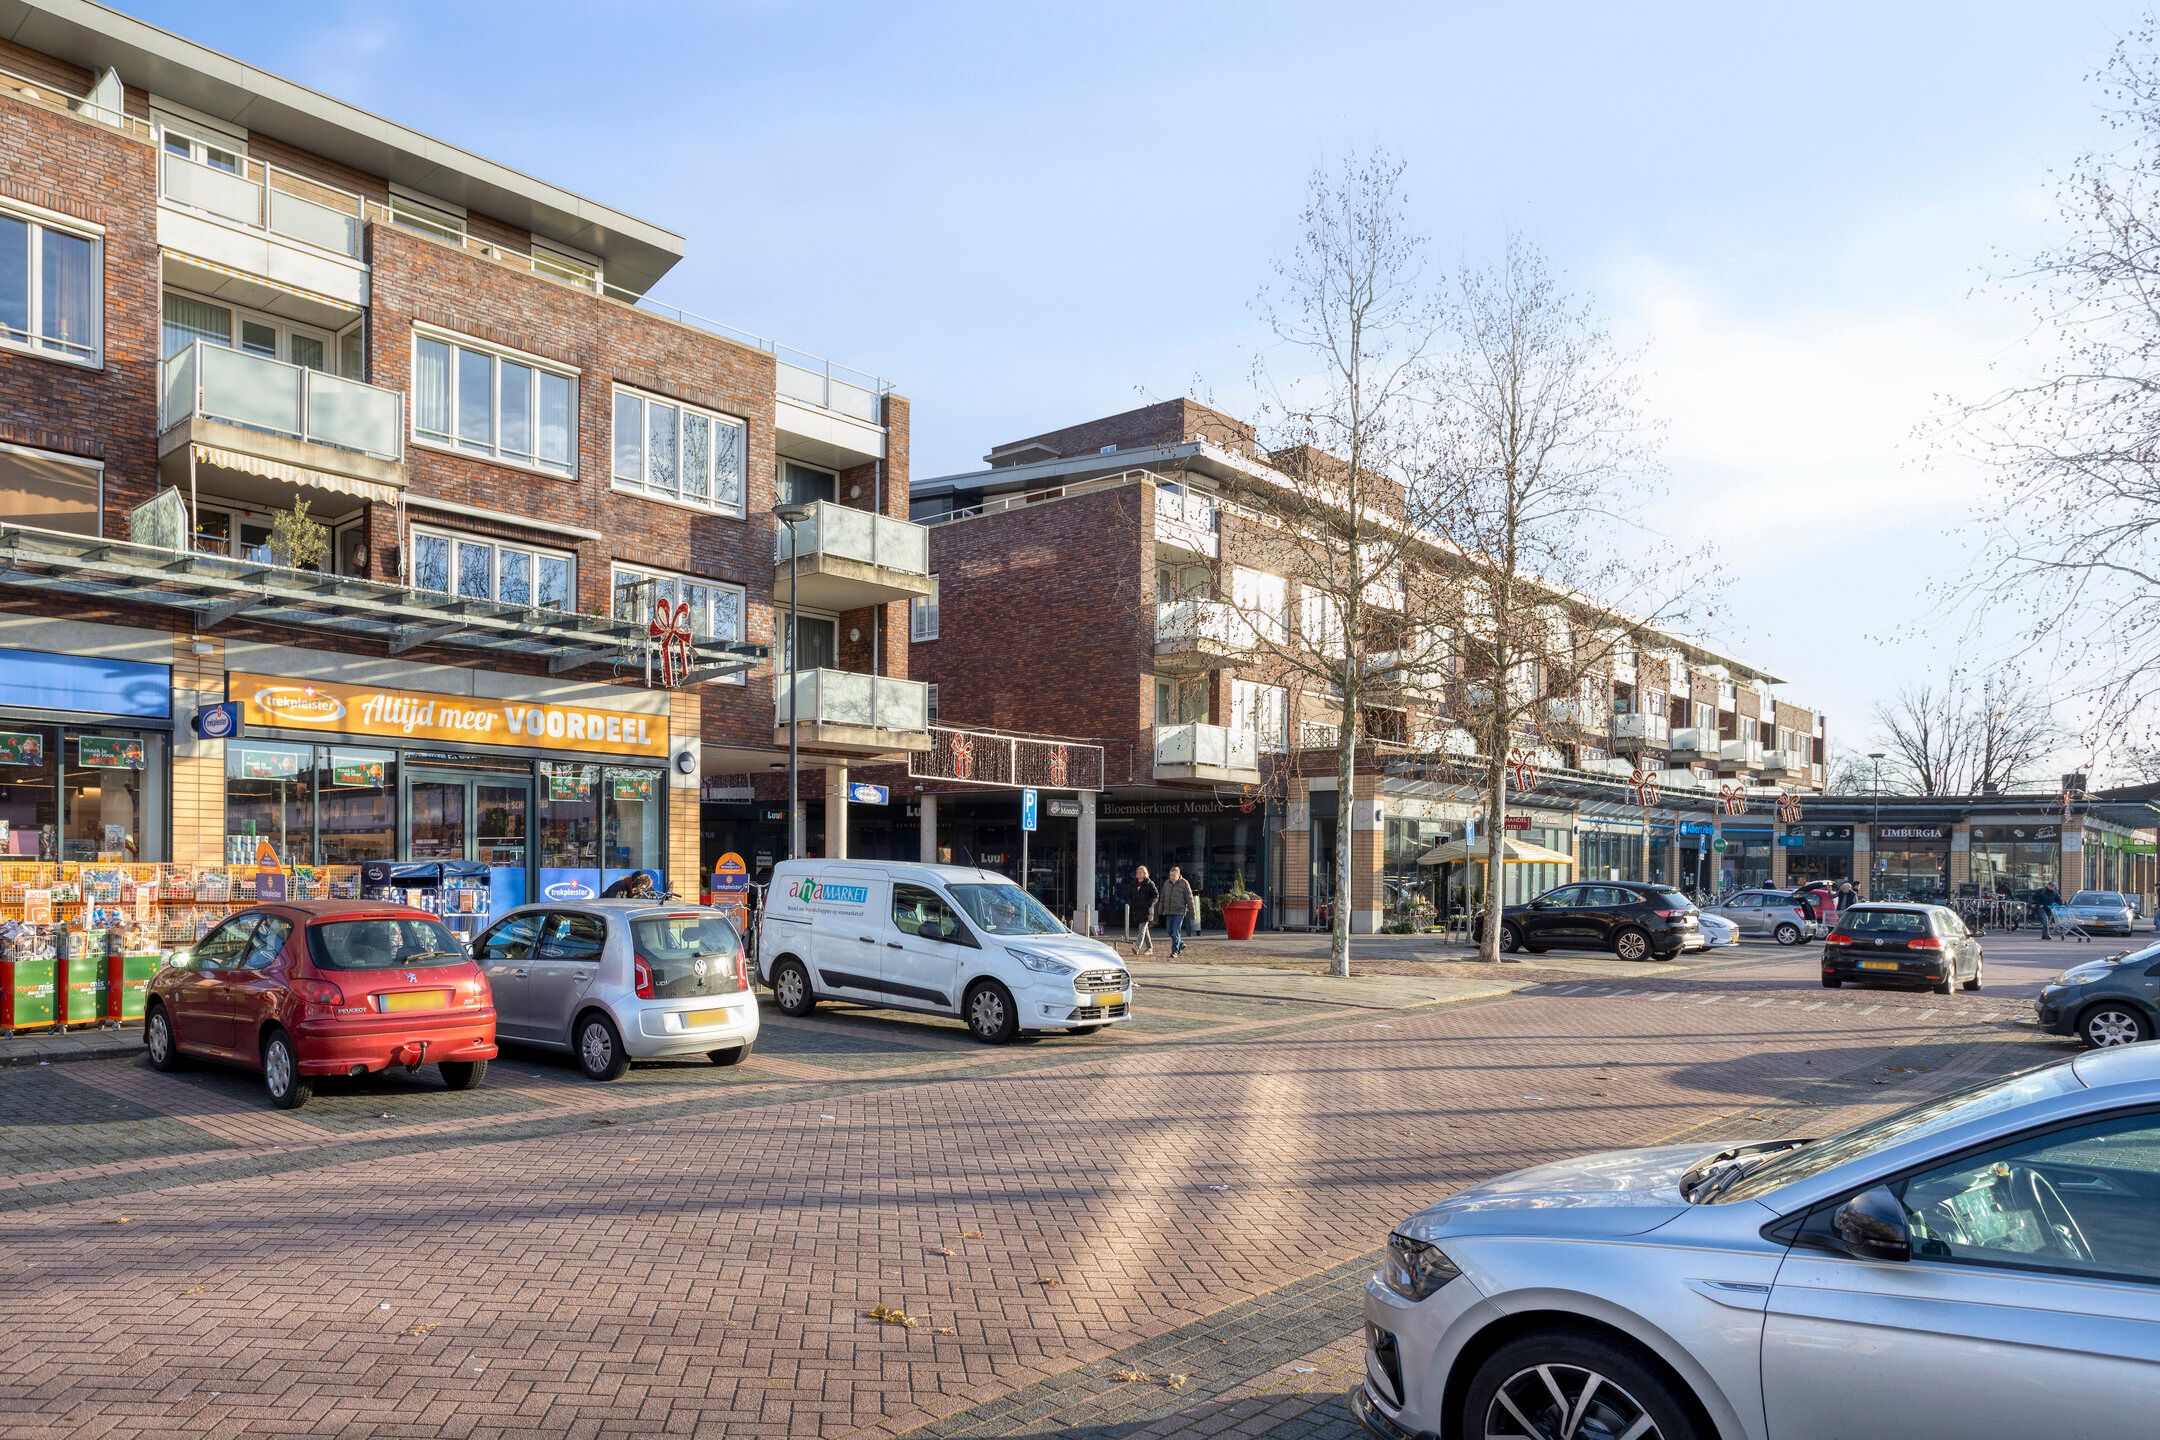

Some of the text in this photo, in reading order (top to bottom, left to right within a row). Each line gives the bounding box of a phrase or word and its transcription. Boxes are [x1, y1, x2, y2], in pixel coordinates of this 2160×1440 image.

[267, 695, 335, 711] trekpleister
[361, 693, 652, 745] Altijd meer VOORDEEL
[1026, 793, 1035, 813] P
[1104, 803, 1180, 814] Bloemsierkunst
[1881, 829, 1942, 838] LIMBURGIA
[550, 887, 588, 897] trekpleister
